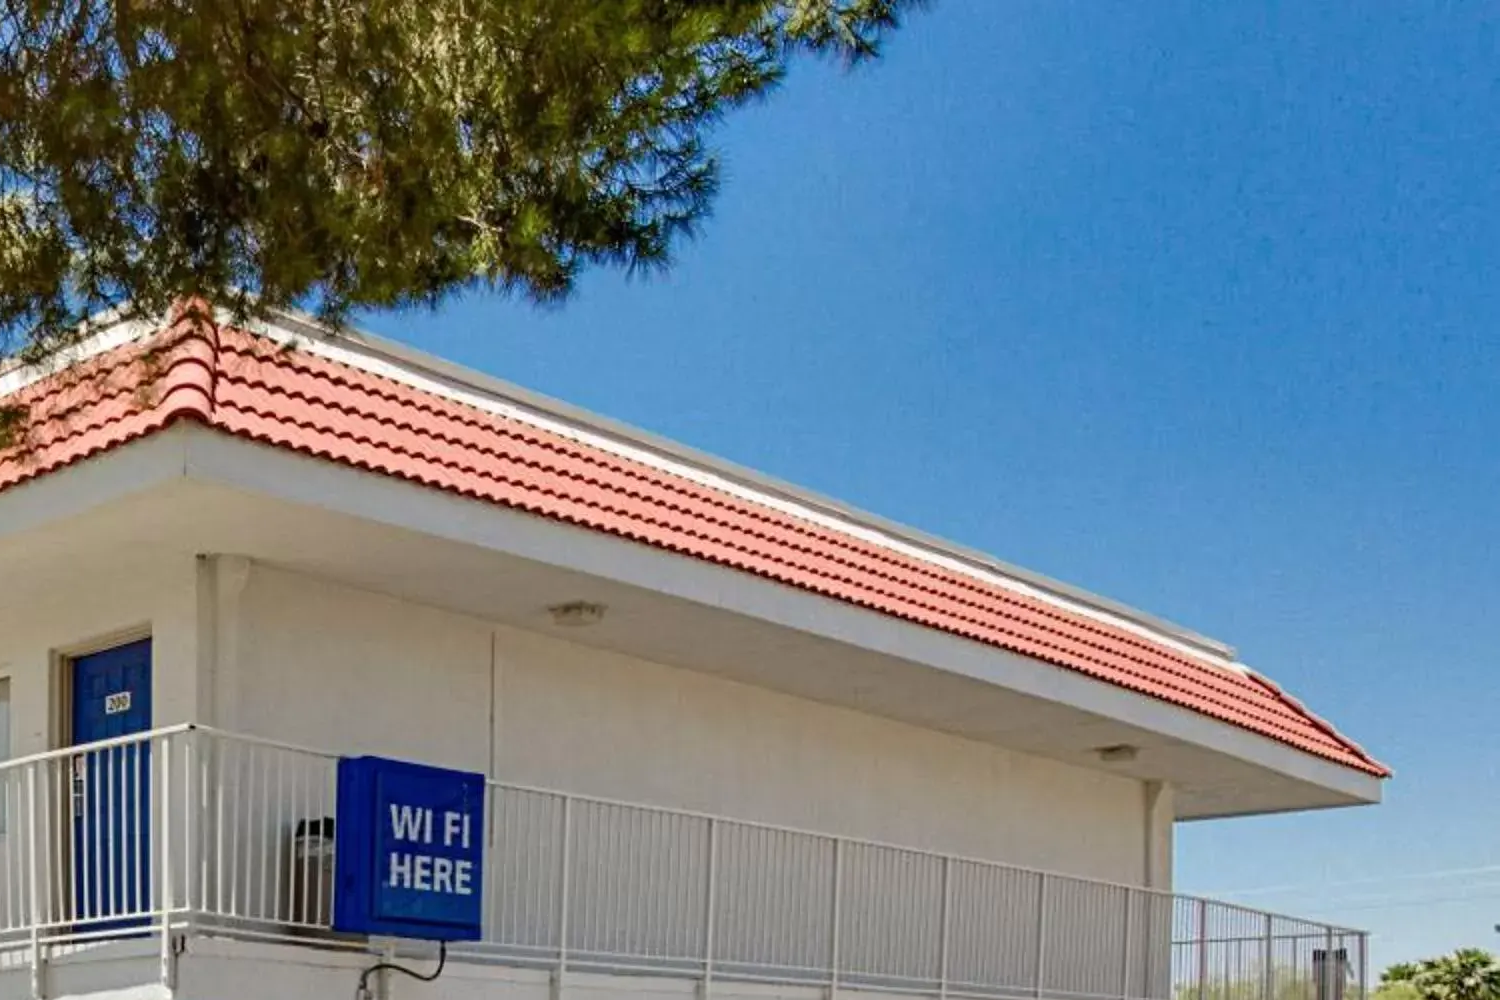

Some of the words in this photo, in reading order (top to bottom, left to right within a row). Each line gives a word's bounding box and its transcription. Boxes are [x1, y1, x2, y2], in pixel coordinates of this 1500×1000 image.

[389, 803, 433, 844] WI
[444, 811, 470, 849] FI
[389, 851, 473, 895] HERE
